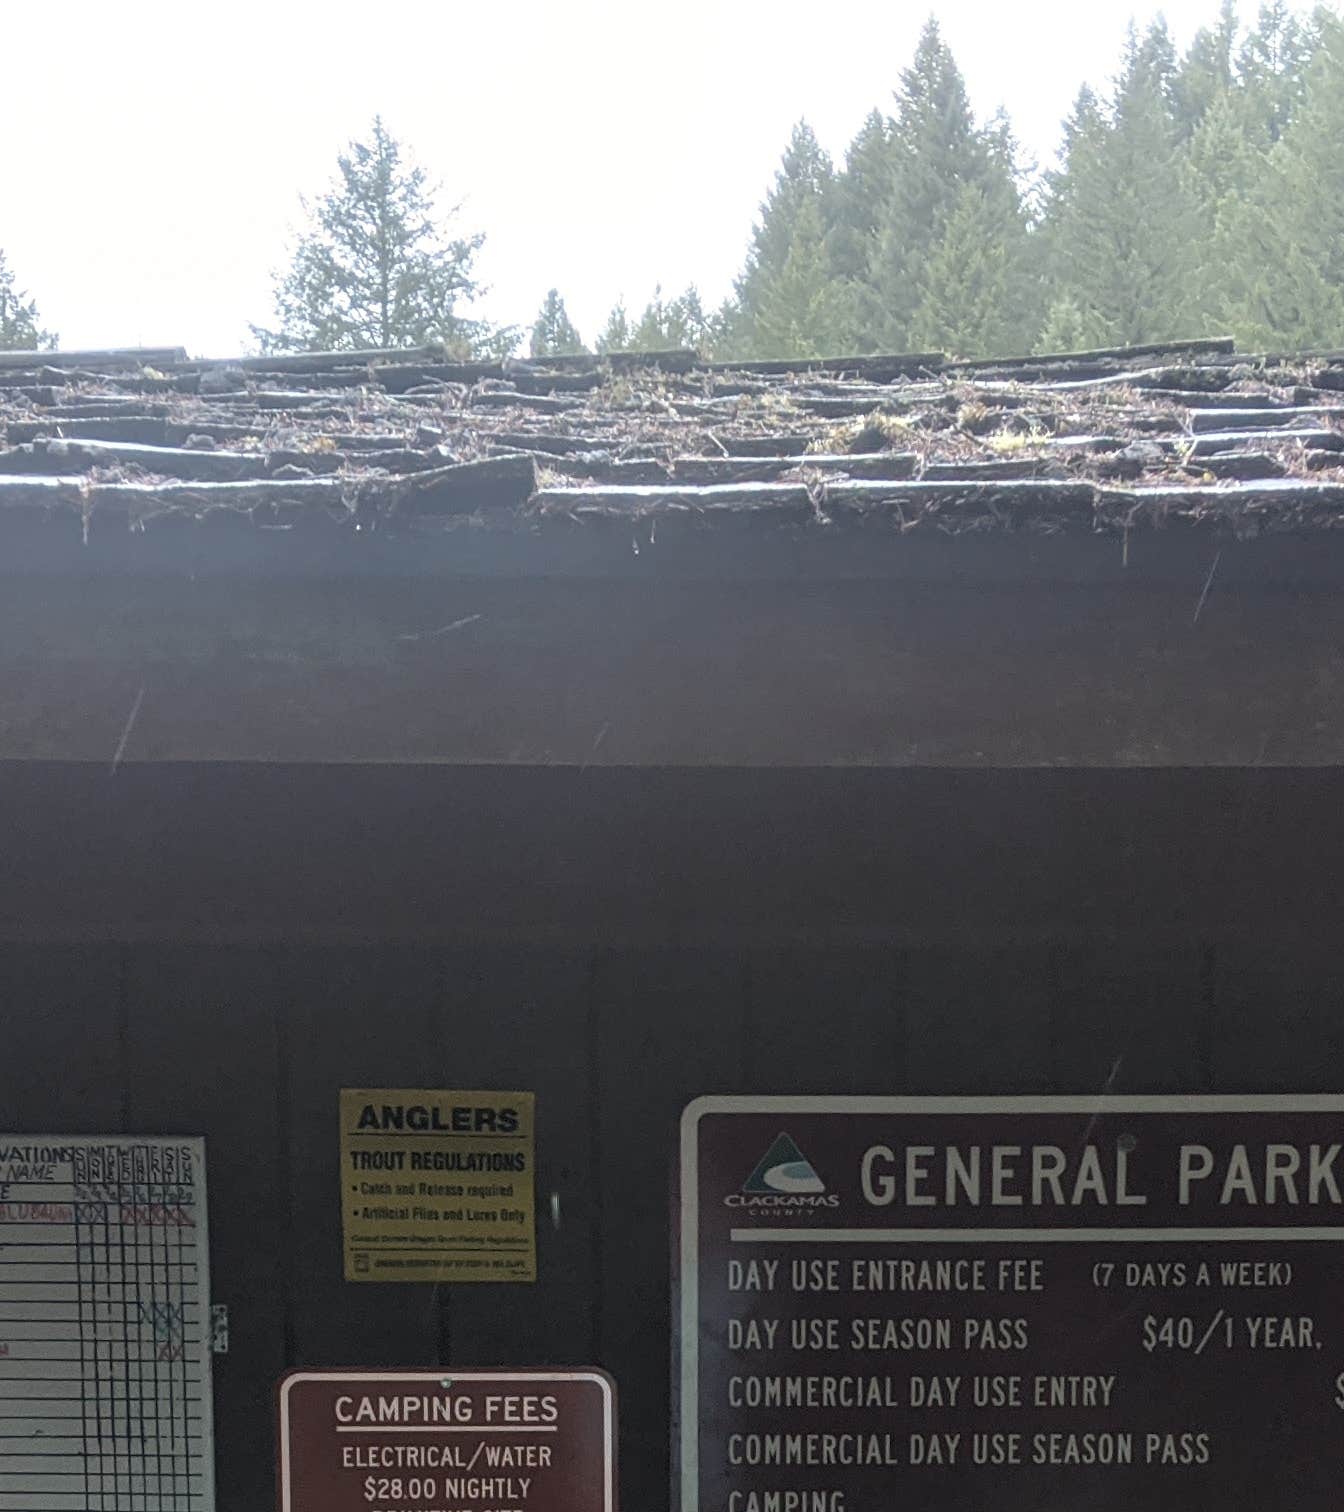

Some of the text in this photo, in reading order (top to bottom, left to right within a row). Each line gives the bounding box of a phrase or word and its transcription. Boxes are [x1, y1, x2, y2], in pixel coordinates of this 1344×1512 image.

[358, 1105, 519, 1132] ANGLERS
[5, 1165, 54, 1181] NAME
[350, 1151, 525, 1172] TROUT REGULATIONS
[861, 1145, 1146, 1206] GENERAL
[1179, 1144, 1342, 1205] PARK
[361, 1183, 392, 1196] Catch
[395, 1184, 415, 1195] and
[419, 1184, 463, 1196] Release
[723, 1195, 840, 1207] CLACKAMAS
[443, 1209, 463, 1221] and
[501, 1209, 525, 1224] Only
[728, 1259, 1044, 1291] DAY USE ENTRANCE FEE
[1092, 1262, 1292, 1287] (7 DAYS A WEEK)
[728, 1318, 1028, 1350] DAY USE SEASON PASS
[1142, 1309, 1233, 1355] $40/1
[728, 1375, 1115, 1408] COMMERCIAL DAY USE ENTRY
[336, 1396, 557, 1423] CAMPING FEES
[342, 1441, 552, 1471] ELECTRICAL/WATER
[728, 1433, 1210, 1465] COMMERCIAL DAY USE SEASON PASS
[364, 1475, 531, 1502] $28.00 NIGHTLY
